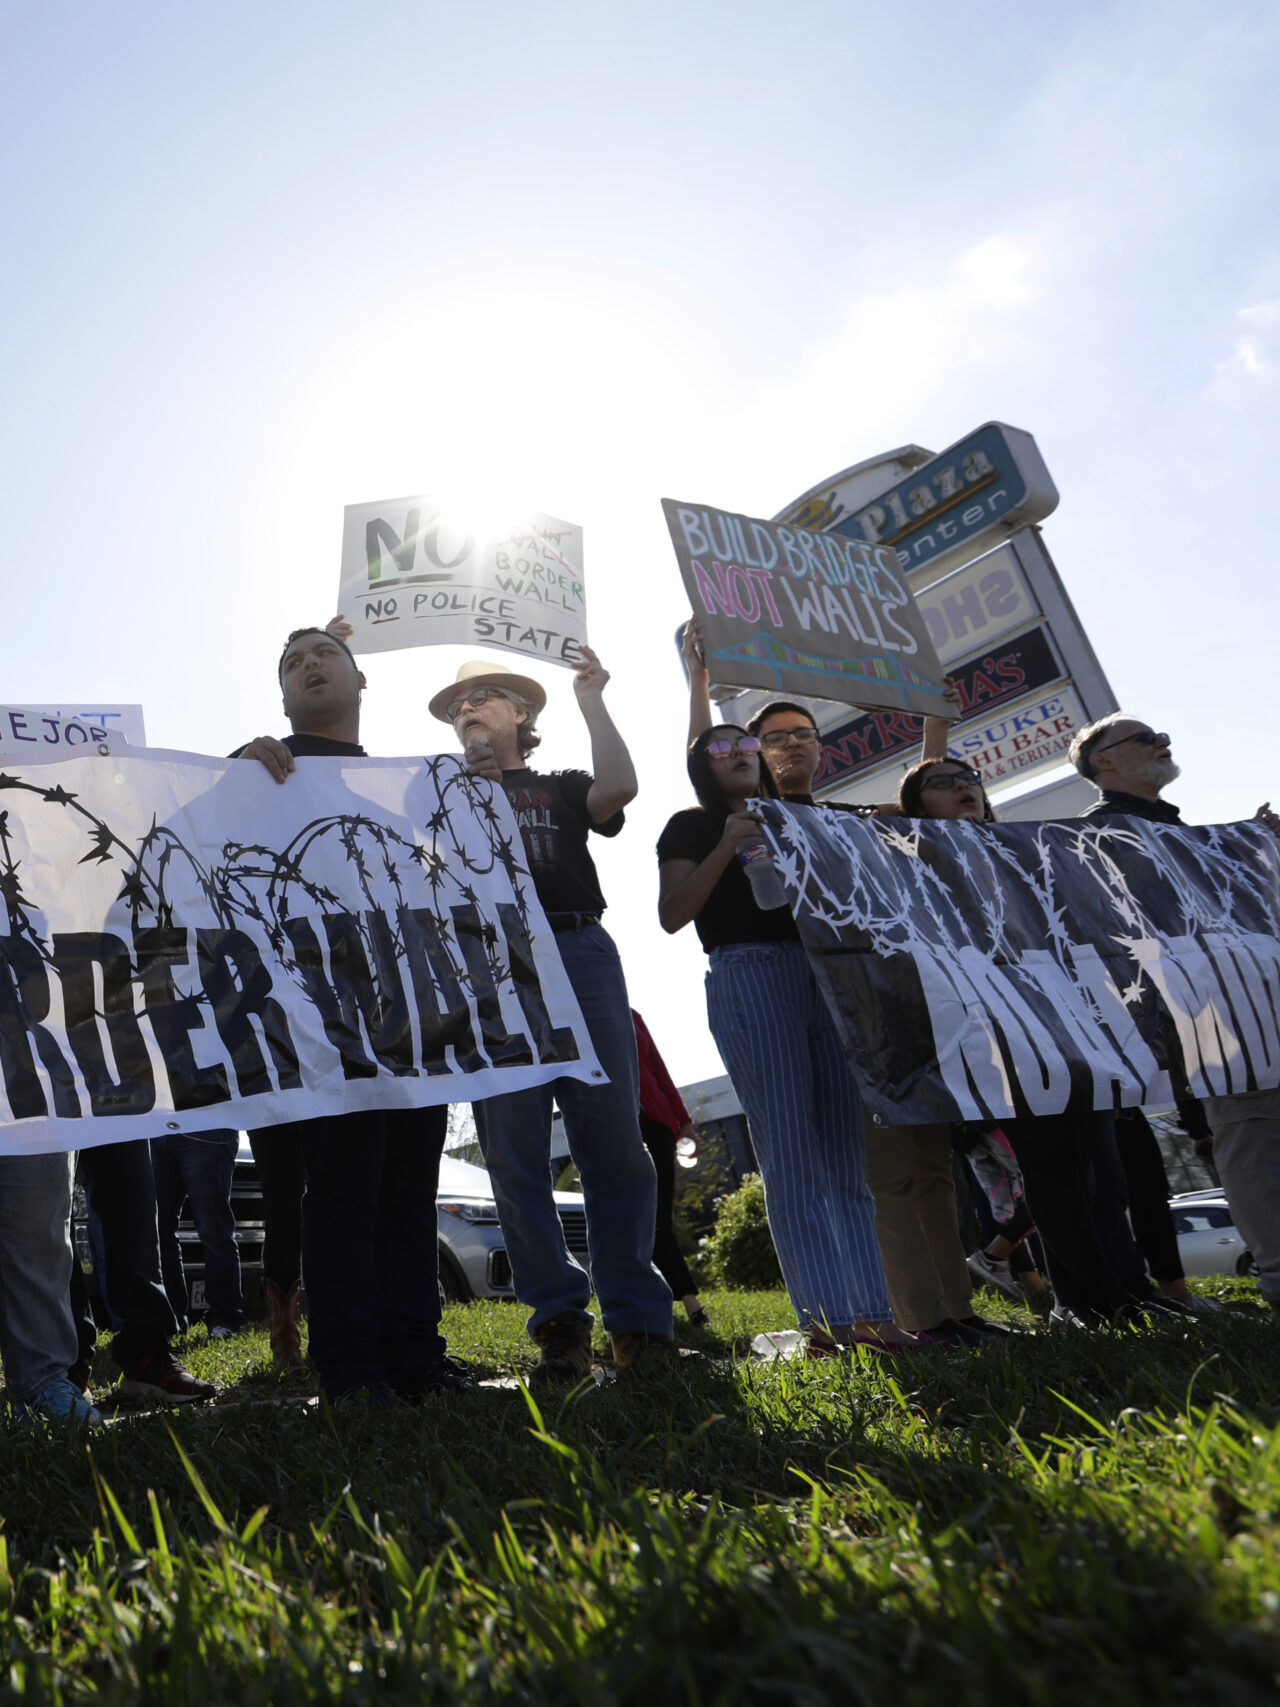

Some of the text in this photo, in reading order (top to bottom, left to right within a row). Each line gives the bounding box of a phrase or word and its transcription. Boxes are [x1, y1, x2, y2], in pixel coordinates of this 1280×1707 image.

[856, 450, 995, 544] Plaza
[365, 508, 475, 580] NO
[676, 508, 909, 607] BUILD BRIDGES
[365, 591, 517, 620] NO POLICE
[495, 551, 584, 603] BORDER
[495, 574, 578, 613] WALL
[690, 559, 918, 655] NOT WALLS
[473, 618, 583, 662] STATE
[1012, 716, 1074, 751] BAR
[280, 903, 581, 1080] WALL
